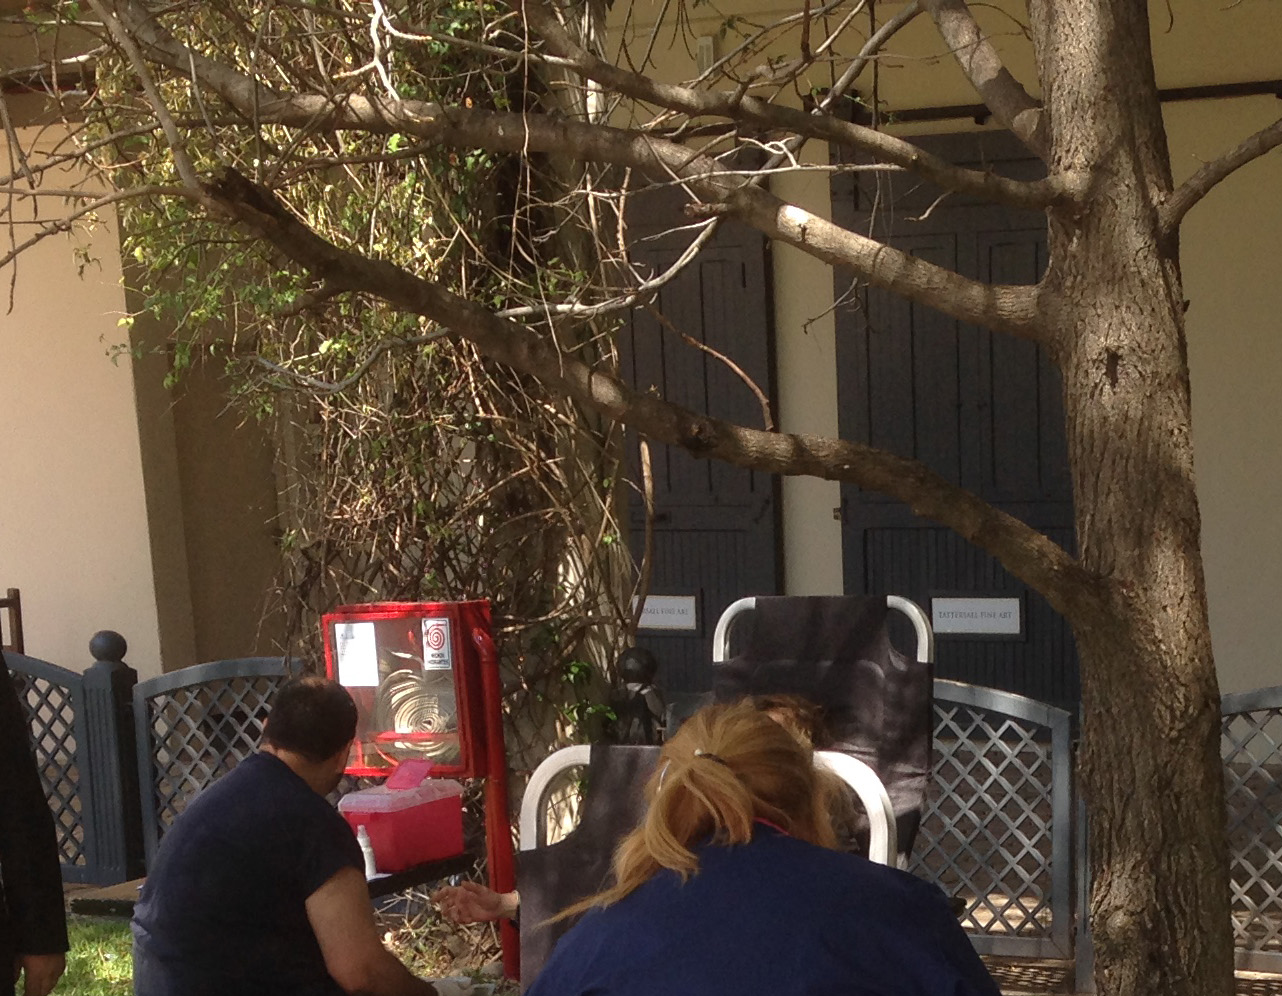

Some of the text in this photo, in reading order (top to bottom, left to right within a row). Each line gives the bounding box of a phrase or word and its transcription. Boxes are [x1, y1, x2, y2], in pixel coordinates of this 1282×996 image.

[938, 611, 1013, 619] TATTERSALL FINE ART
